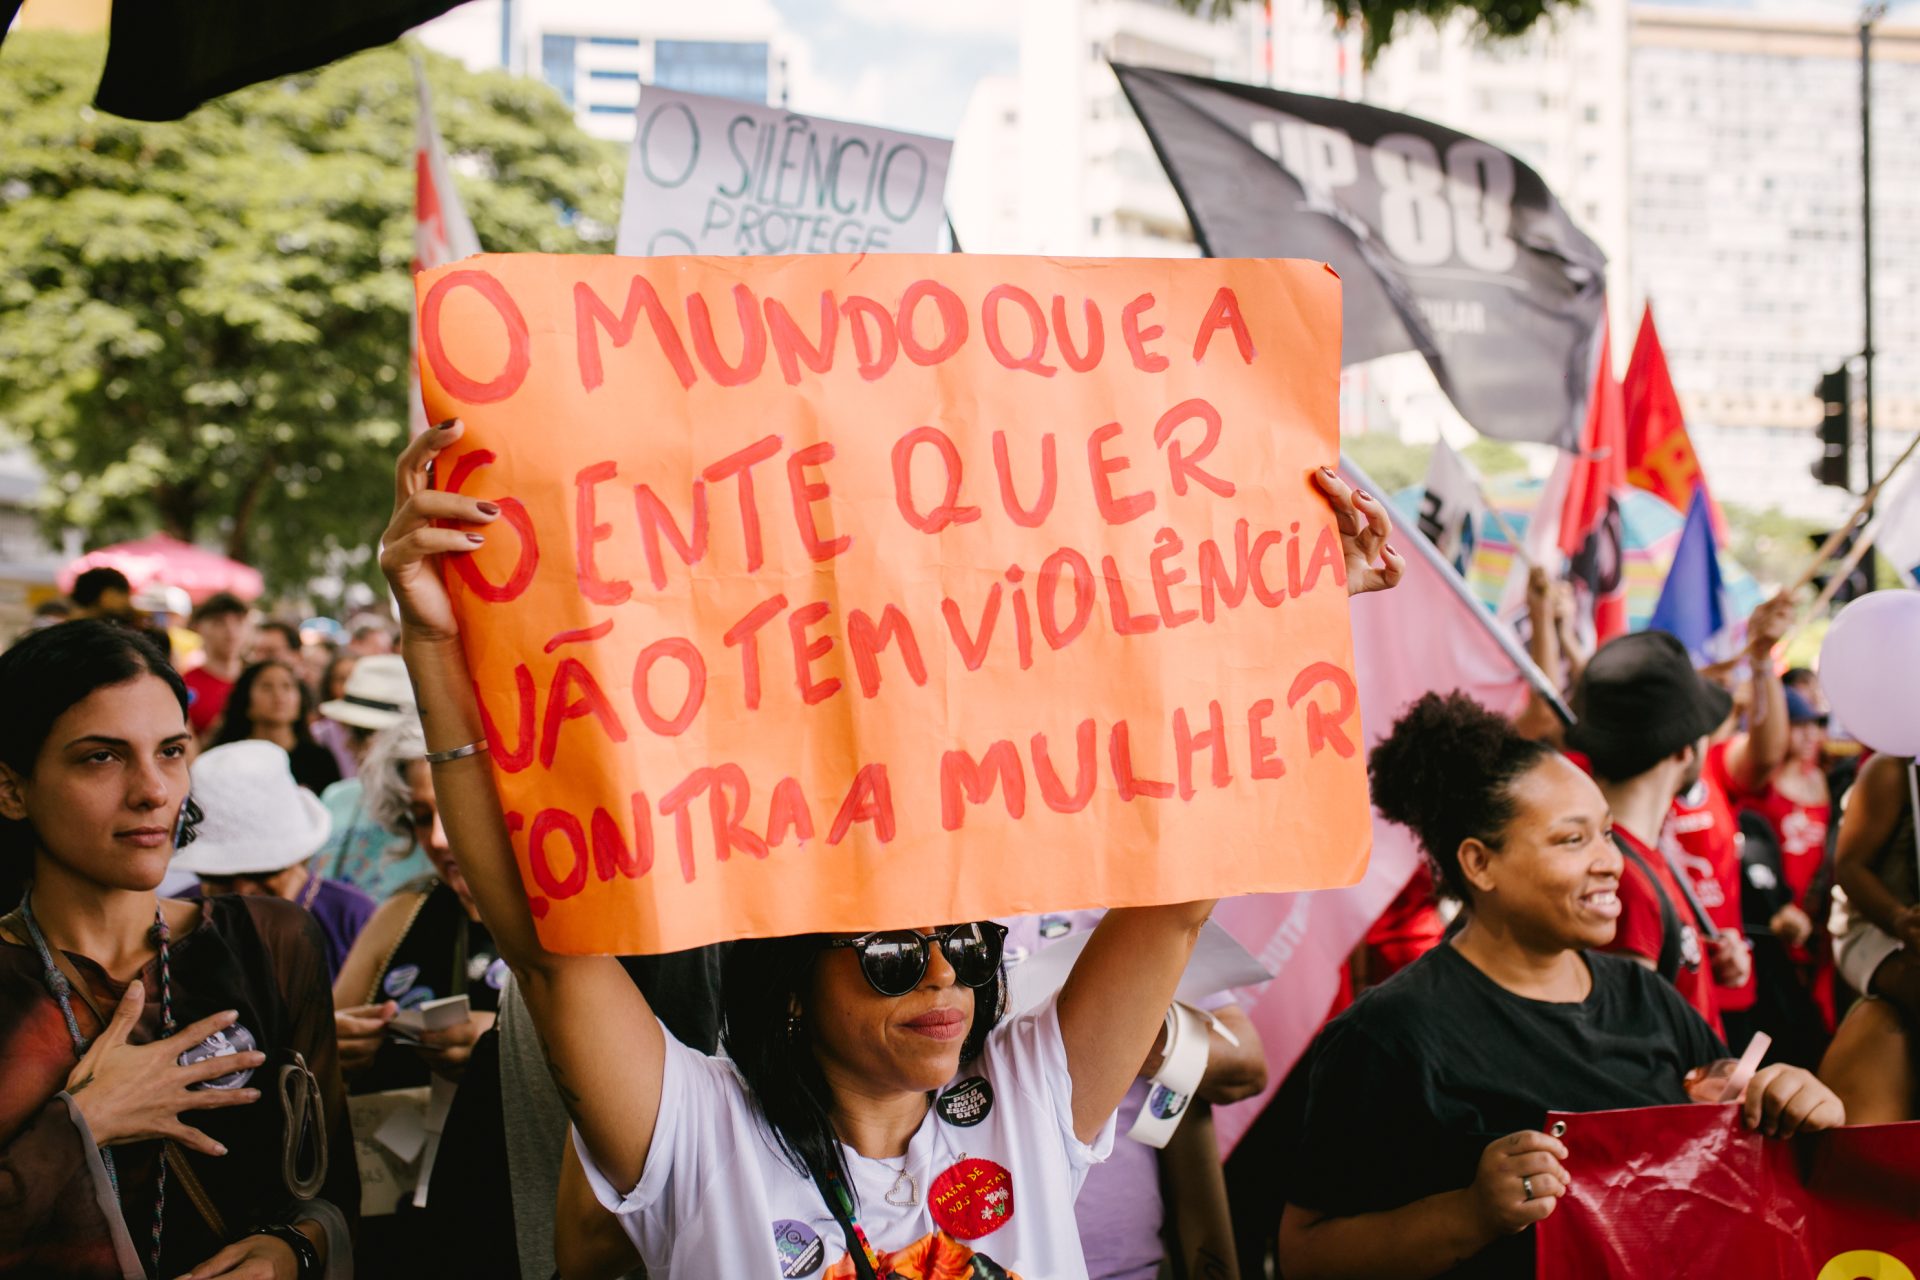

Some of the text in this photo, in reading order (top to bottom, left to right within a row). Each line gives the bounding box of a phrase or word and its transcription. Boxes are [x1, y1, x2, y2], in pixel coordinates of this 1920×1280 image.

[640, 102, 929, 224] O SILÊNCIO
[701, 197, 892, 256] PROTEGE
[422, 270, 1256, 403] O MUNDO QUE A
[443, 398, 1237, 604] GENTE QUER
[724, 594, 928, 710] TEM
[827, 763, 897, 845] A
[940, 661, 1357, 832] MULHER
[946, 1098, 987, 1115] ESCALA
[948, 1092, 984, 1110] FIM DA
[953, 1088, 978, 1103] PELO
[967, 1167, 984, 1182] DE
